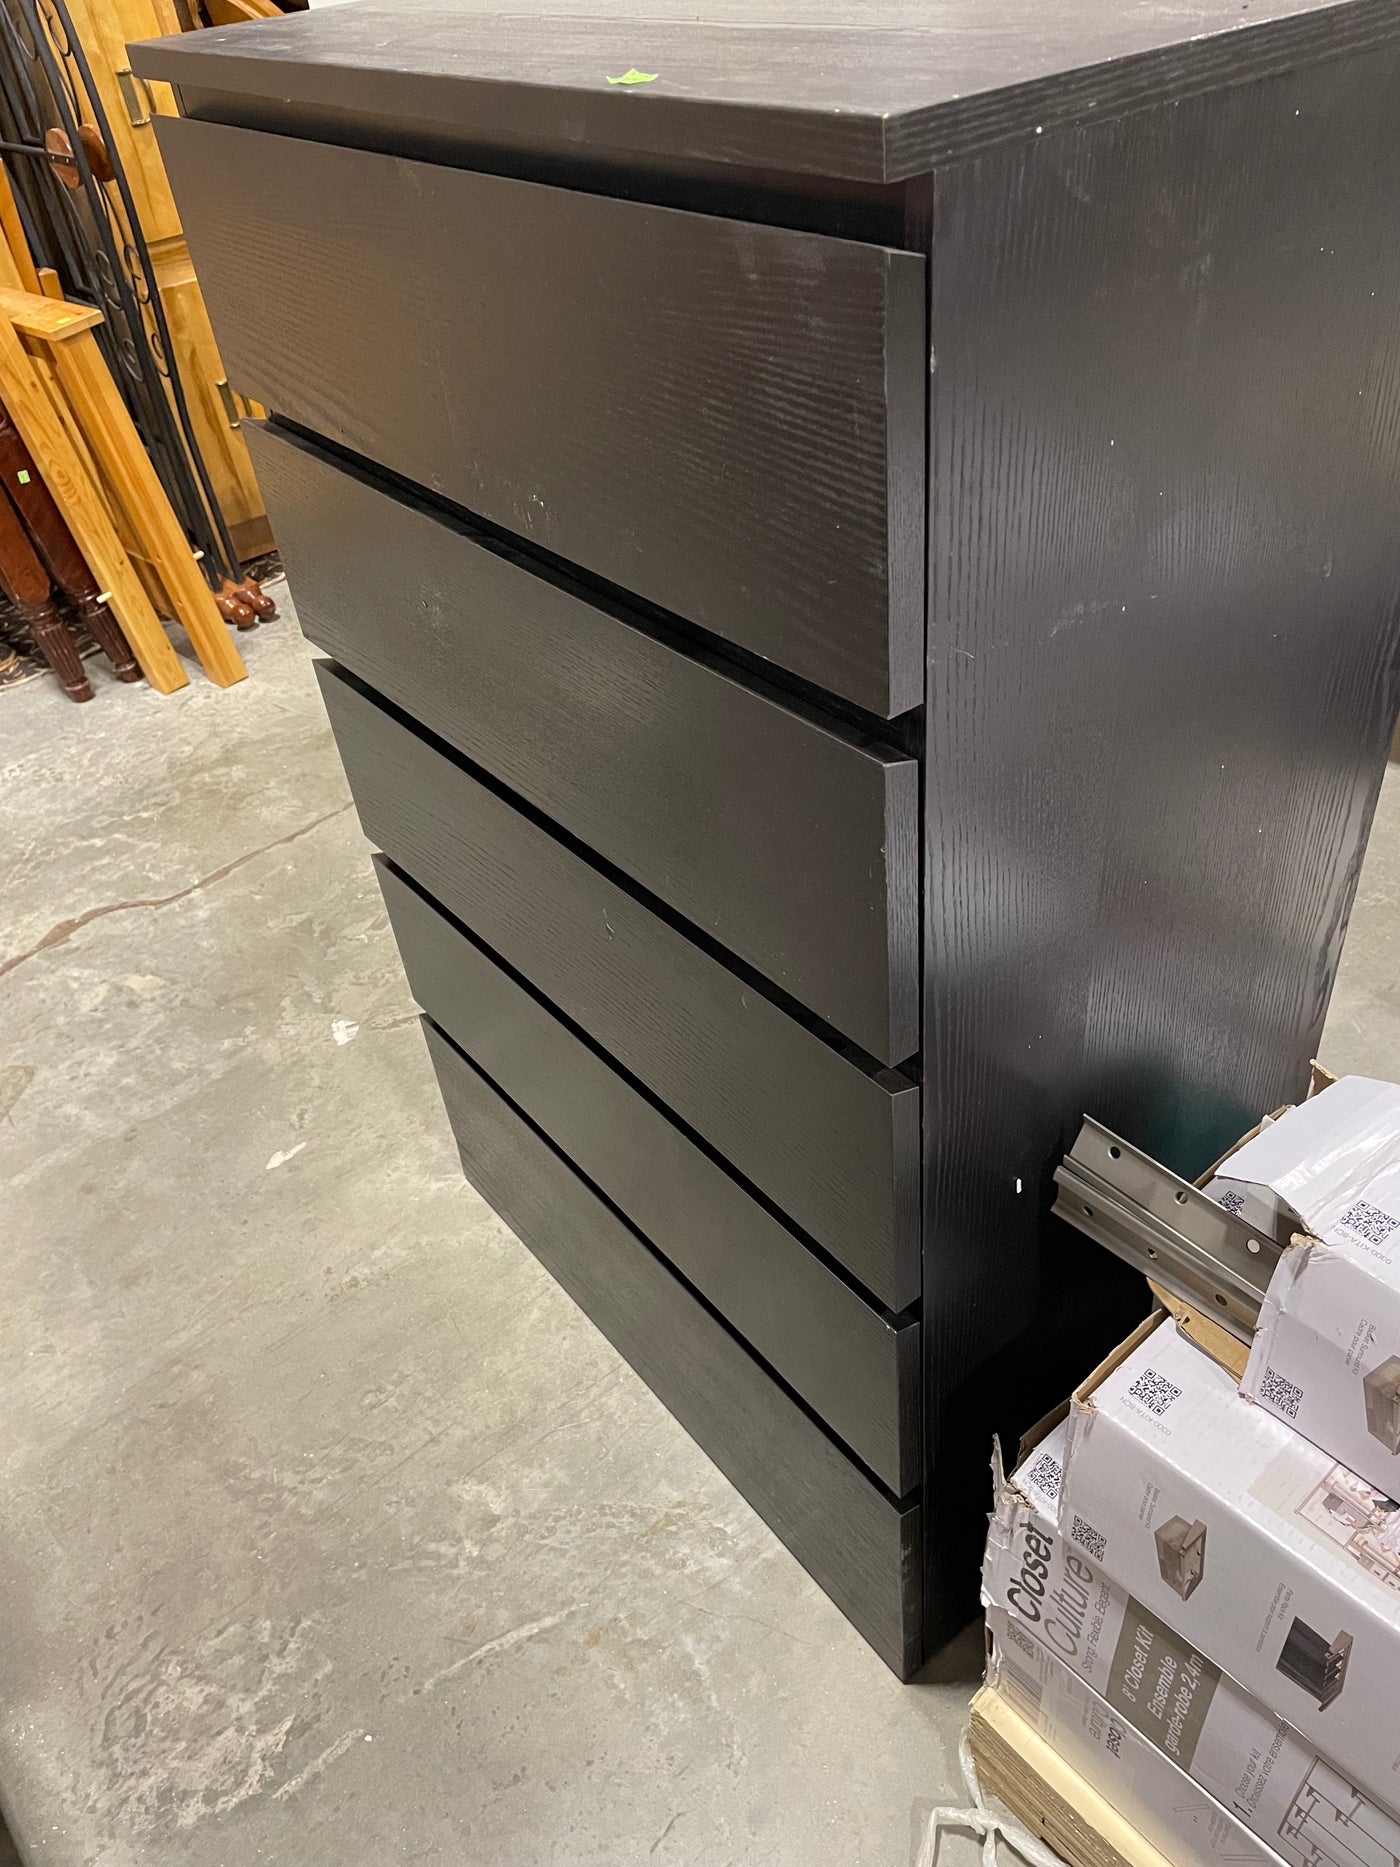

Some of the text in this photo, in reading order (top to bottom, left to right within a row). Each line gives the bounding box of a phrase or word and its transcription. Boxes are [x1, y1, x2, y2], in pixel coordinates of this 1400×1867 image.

[1007, 1521, 1054, 1622] Closet
[1044, 1555, 1094, 1656] Culture
[1122, 1624, 1155, 1703] 8' Closet Kit
[1147, 1655, 1179, 1719] Ensemble
[1106, 1717, 1128, 1760] Closet
[1164, 1653, 1204, 1756] garde-robe 2,4m
[1261, 1756, 1275, 1776] votre
[1232, 1800, 1254, 1818] 1.
